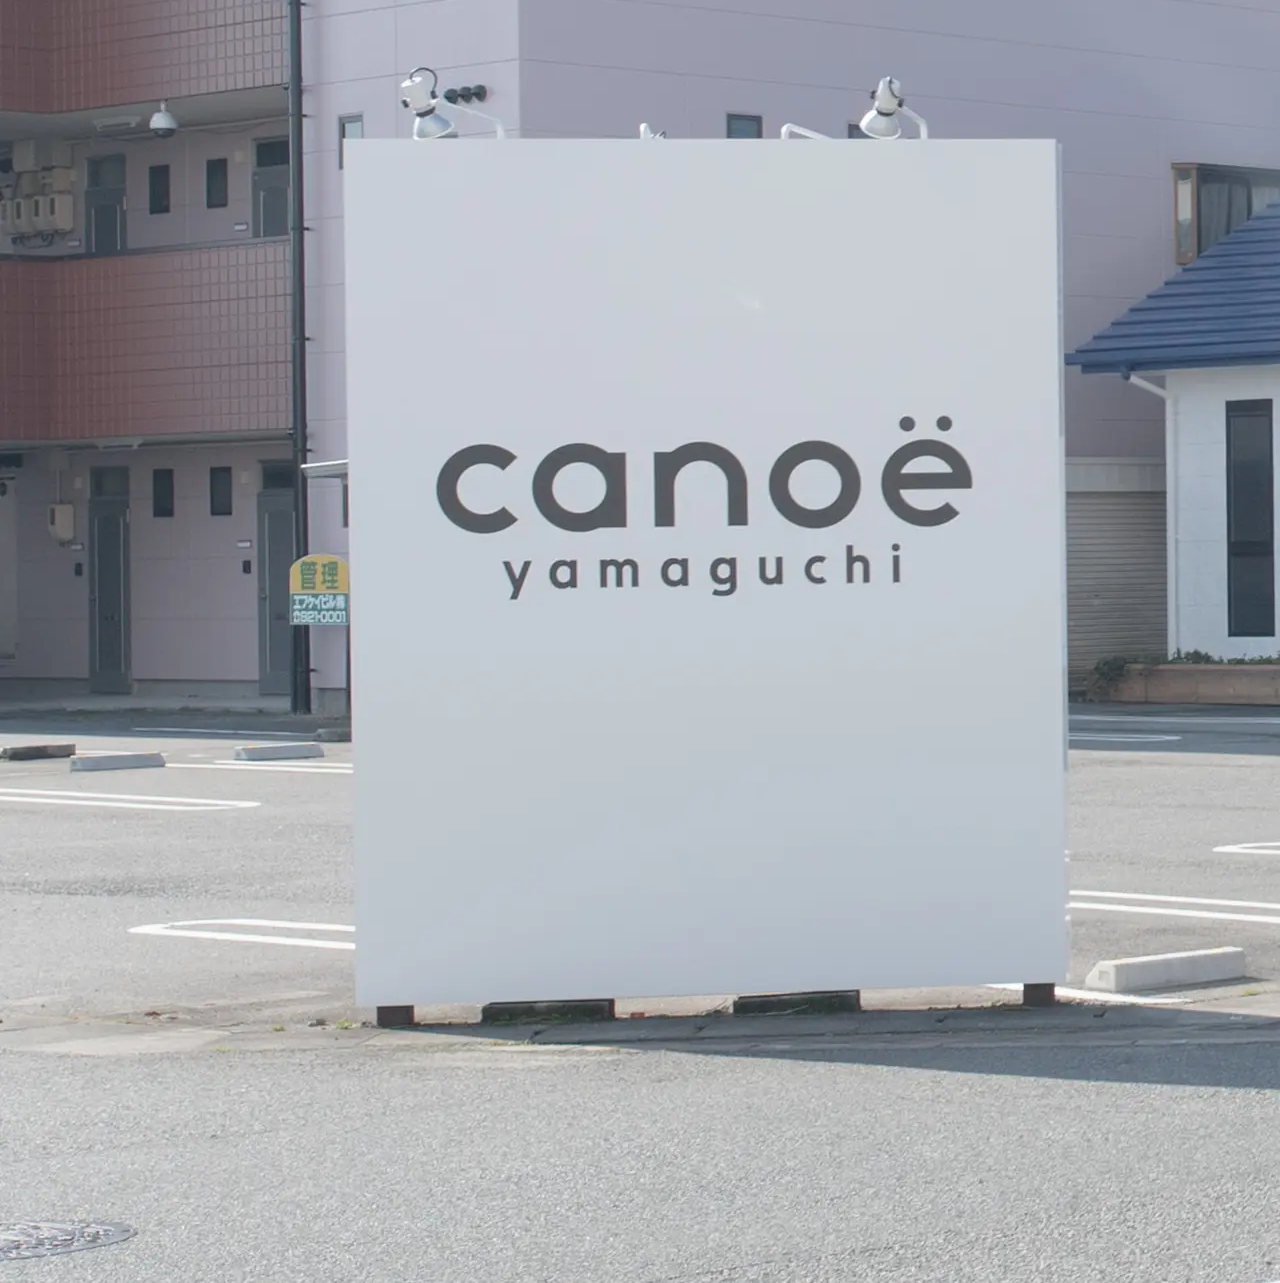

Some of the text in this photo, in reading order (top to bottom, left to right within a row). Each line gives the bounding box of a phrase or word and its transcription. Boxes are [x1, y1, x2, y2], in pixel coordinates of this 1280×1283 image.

[436, 416, 972, 533] canoë
[300, 561, 340, 590] 管理
[502, 543, 901, 600] yamaguchi
